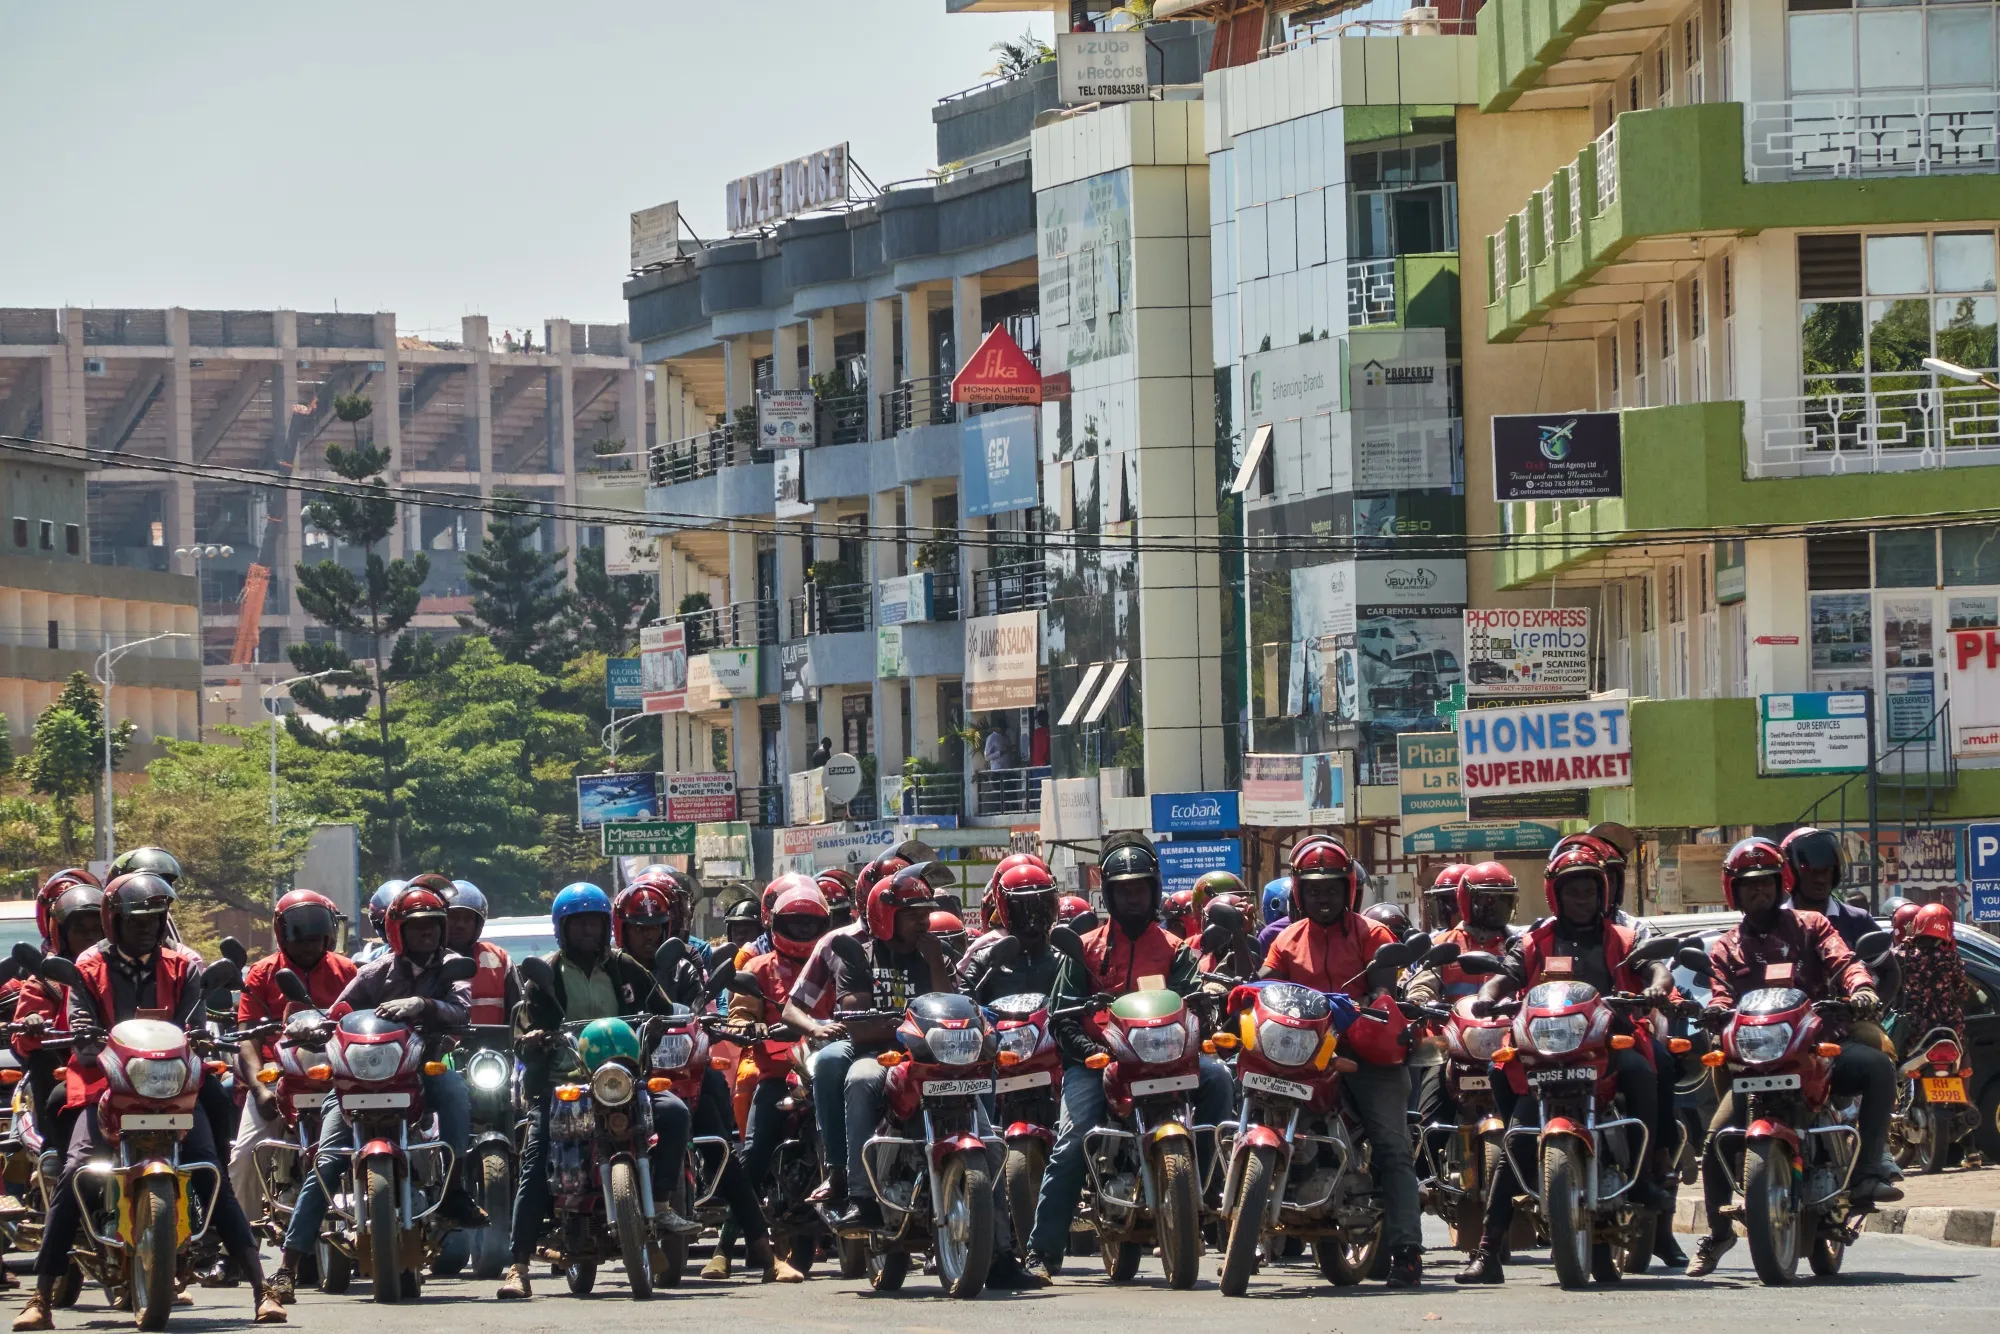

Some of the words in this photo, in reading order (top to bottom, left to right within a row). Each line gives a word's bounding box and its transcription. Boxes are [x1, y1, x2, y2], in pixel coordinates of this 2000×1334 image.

[1104, 55, 1112, 65] &
[1078, 85, 1096, 96] TEL:
[1098, 84, 1145, 95] 0788433581
[782, 146, 843, 216] HOUSE
[1046, 226, 1068, 258] WAP
[976, 348, 1018, 379] Sika
[1385, 366, 1434, 378] PROPERTY
[1272, 379, 1302, 400] Enhancing
[1303, 369, 1324, 392] Brands
[994, 393, 1030, 401] Distributor
[1566, 462, 1587, 470] Agency
[1510, 471, 1532, 480] Travel
[1533, 472, 1546, 480] and
[1467, 610, 1520, 627] PHOTO
[1523, 610, 1587, 627] EXPRESS
[980, 628, 1006, 657] JAMBO
[1006, 626, 1034, 655] SALON
[1513, 627, 1587, 648] irembo
[611, 676, 630, 684] LAW
[1907, 696, 1930, 704] SERVICES
[1796, 722, 1810, 730] OUR
[1811, 721, 1840, 729] SERVICES
[1465, 709, 1624, 754] HONEST
[830, 767, 855, 775] CANAL+
[1465, 752, 1631, 788] SUPERMARKET
[621, 775, 640, 783] AGENCY
[1423, 773, 1441, 788] La
[1171, 799, 1221, 818] Ecobank
[1411, 799, 1459, 809] DUKORANA
[621, 827, 673, 838] MEDIASOL
[785, 833, 808, 846] GOLDEN
[817, 837, 865, 849] SAMSUNG
[608, 843, 688, 853] PHARMACY
[1161, 846, 1195, 855] REMERA
[1196, 845, 1231, 854] BRANCH
[1978, 836, 1998, 866] P
[1976, 883, 1991, 891] PAY
[1932, 1079, 1949, 1089] RH
[1931, 1090, 1961, 1101] 399B
